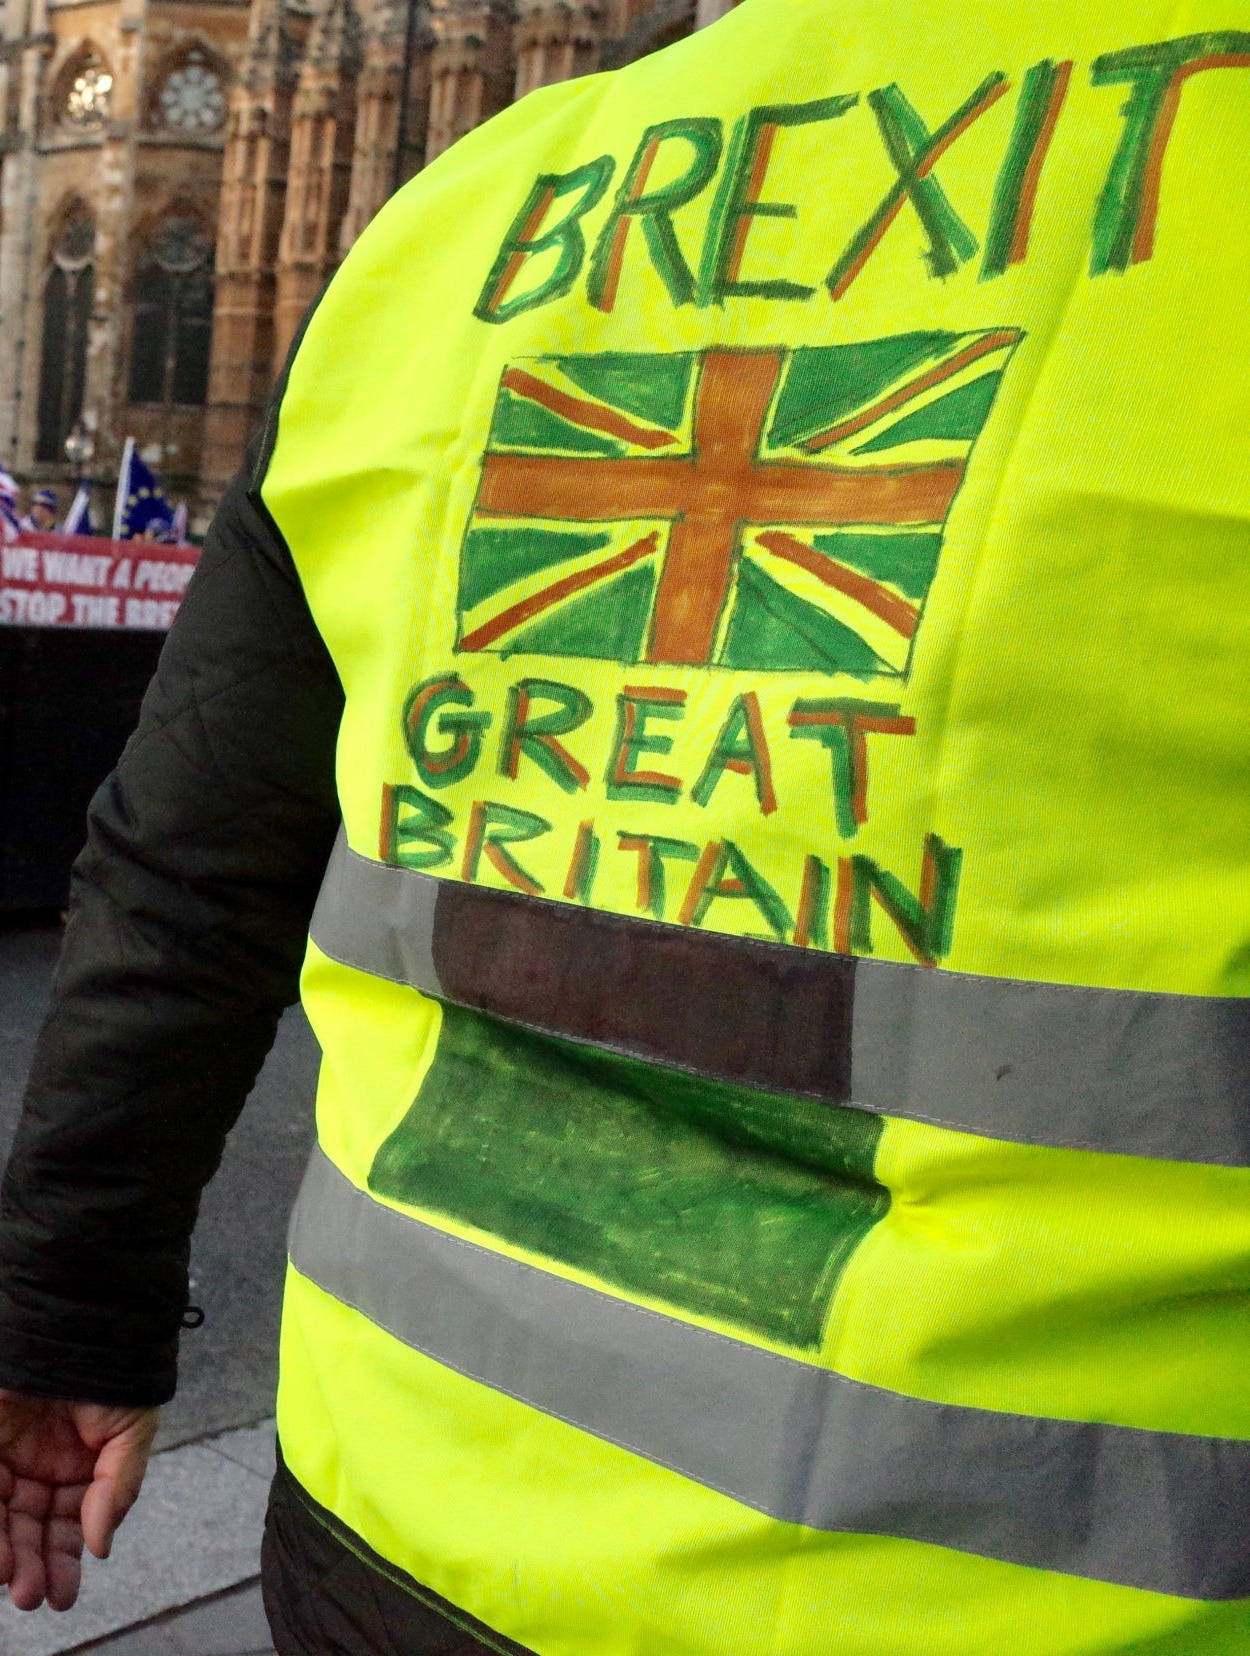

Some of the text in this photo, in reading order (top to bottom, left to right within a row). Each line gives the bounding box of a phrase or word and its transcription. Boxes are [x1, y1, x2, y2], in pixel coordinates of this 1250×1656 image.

[473, 30, 1250, 324] BREXIT
[1, 547, 38, 582] WE
[41, 550, 112, 587] WANT
[112, 558, 132, 589] A
[70, 594, 119, 626] THE
[403, 672, 916, 840] GREAT
[378, 782, 964, 969] BRITAIN
